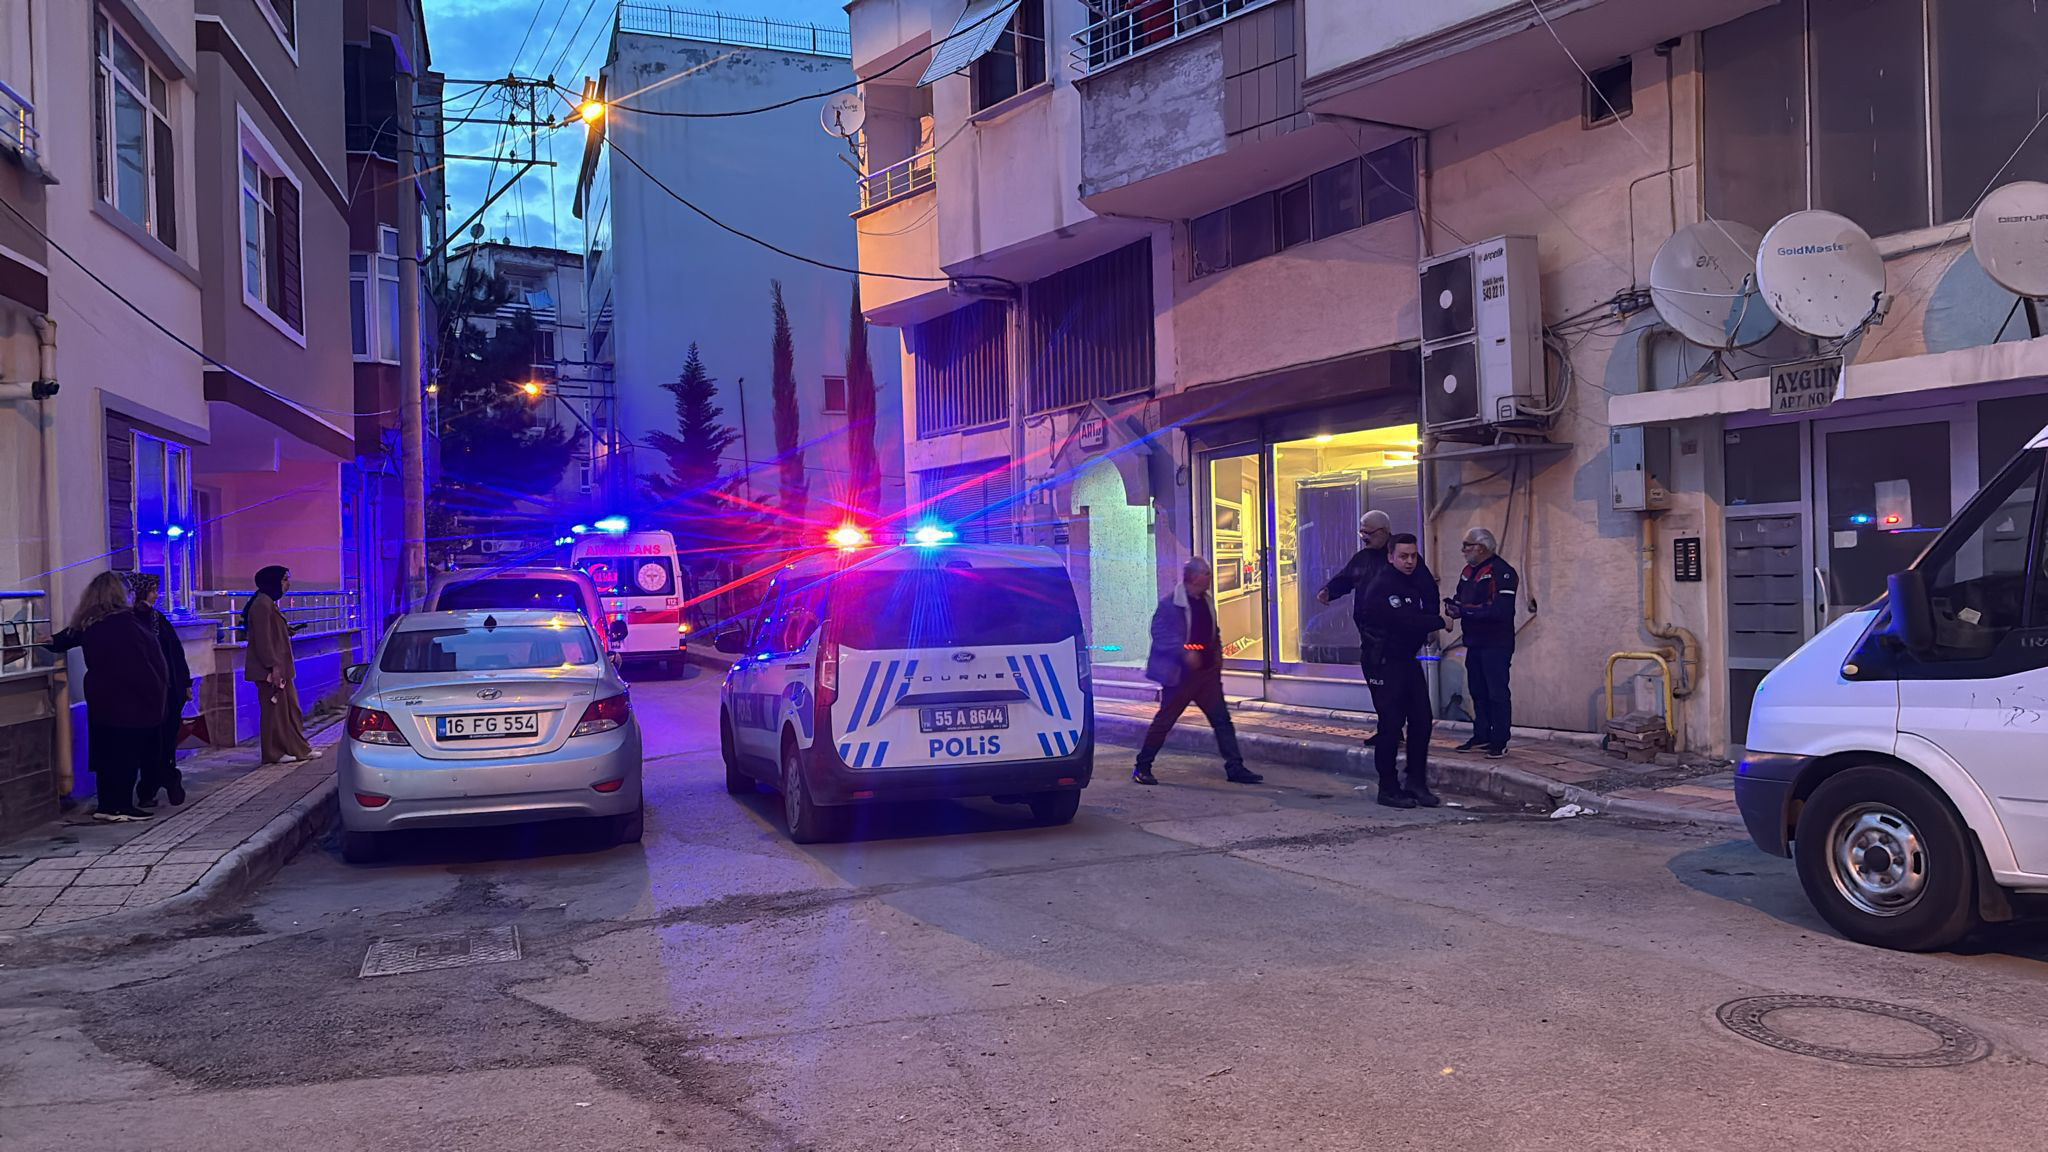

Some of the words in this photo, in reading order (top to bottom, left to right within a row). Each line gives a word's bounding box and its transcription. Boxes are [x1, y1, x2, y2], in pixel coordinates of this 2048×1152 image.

[904, 673, 1021, 682] TOURNEO
[447, 719, 464, 734] 16
[473, 717, 497, 732] FG
[504, 716, 534, 731] 554
[935, 710, 952, 726] 55
[956, 710, 966, 725] A
[970, 708, 1003, 724] 8644
